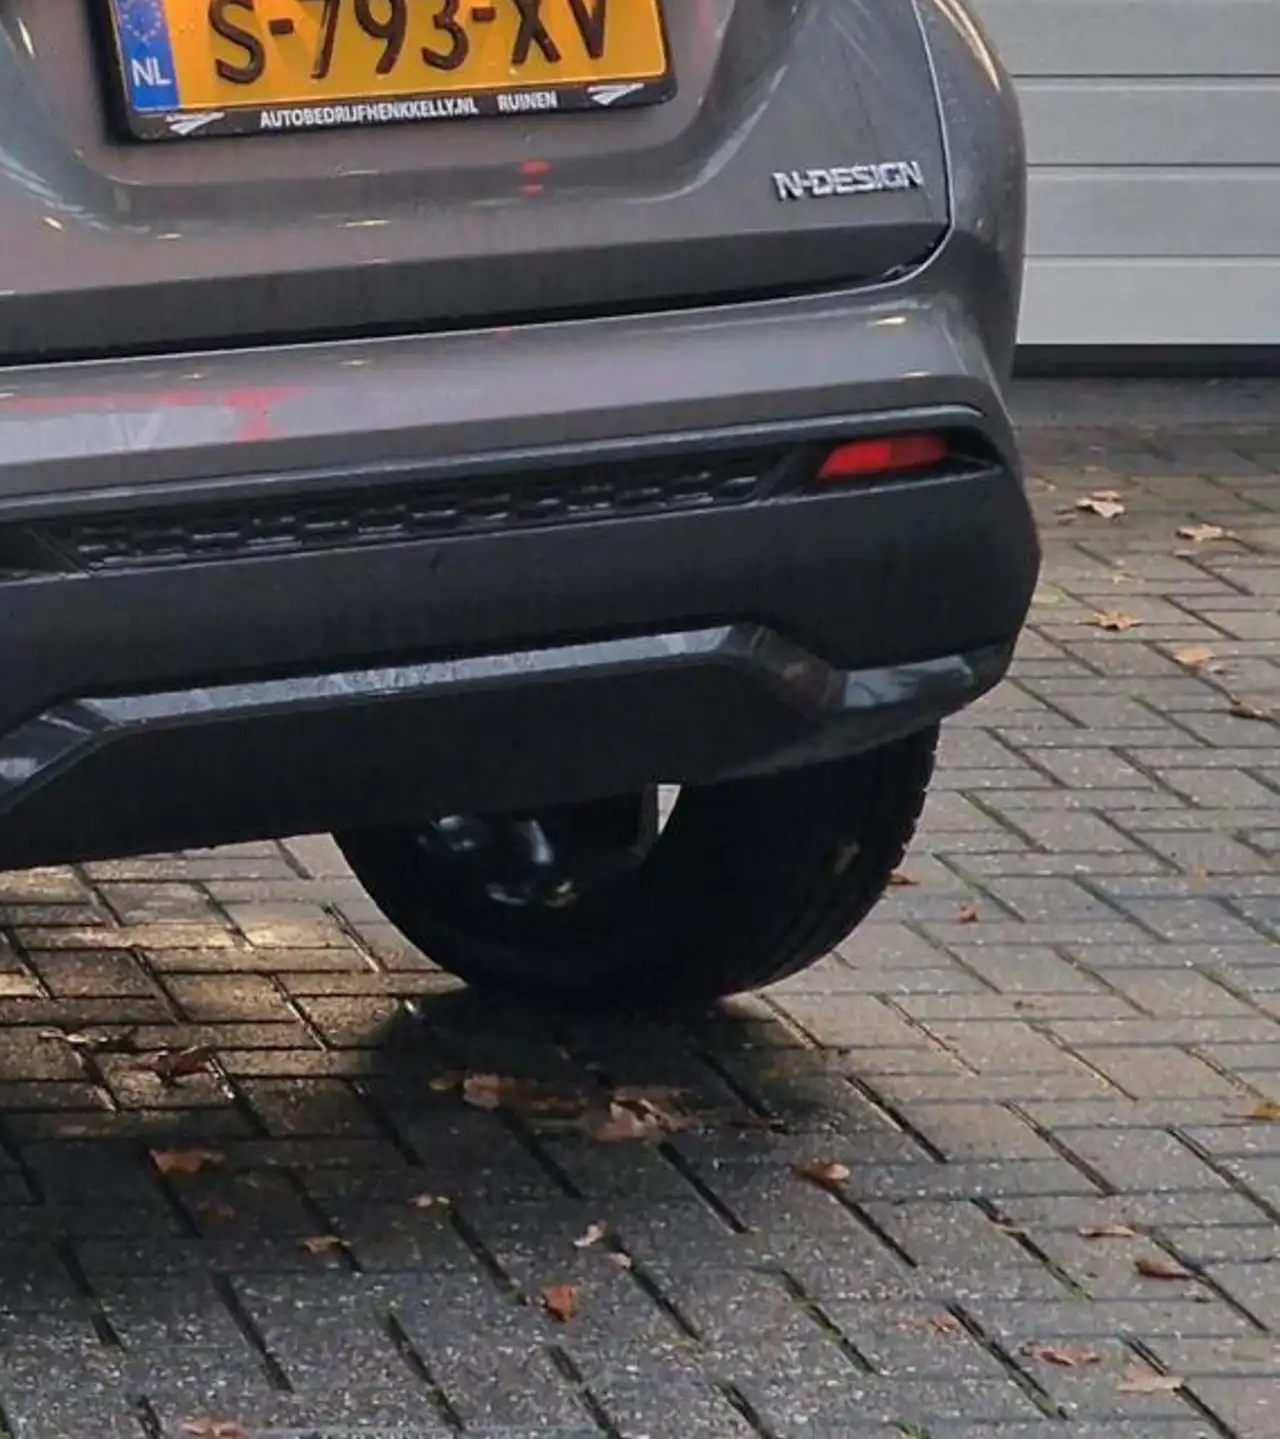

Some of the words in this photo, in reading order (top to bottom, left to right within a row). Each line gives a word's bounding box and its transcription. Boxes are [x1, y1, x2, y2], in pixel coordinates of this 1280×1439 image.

[132, 58, 170, 88] NL
[260, 96, 479, 129] AUTOBEDRIJFHENKKELLY.NL
[497, 90, 559, 112] RUINEN
[771, 160, 924, 201] N-DESIGN
